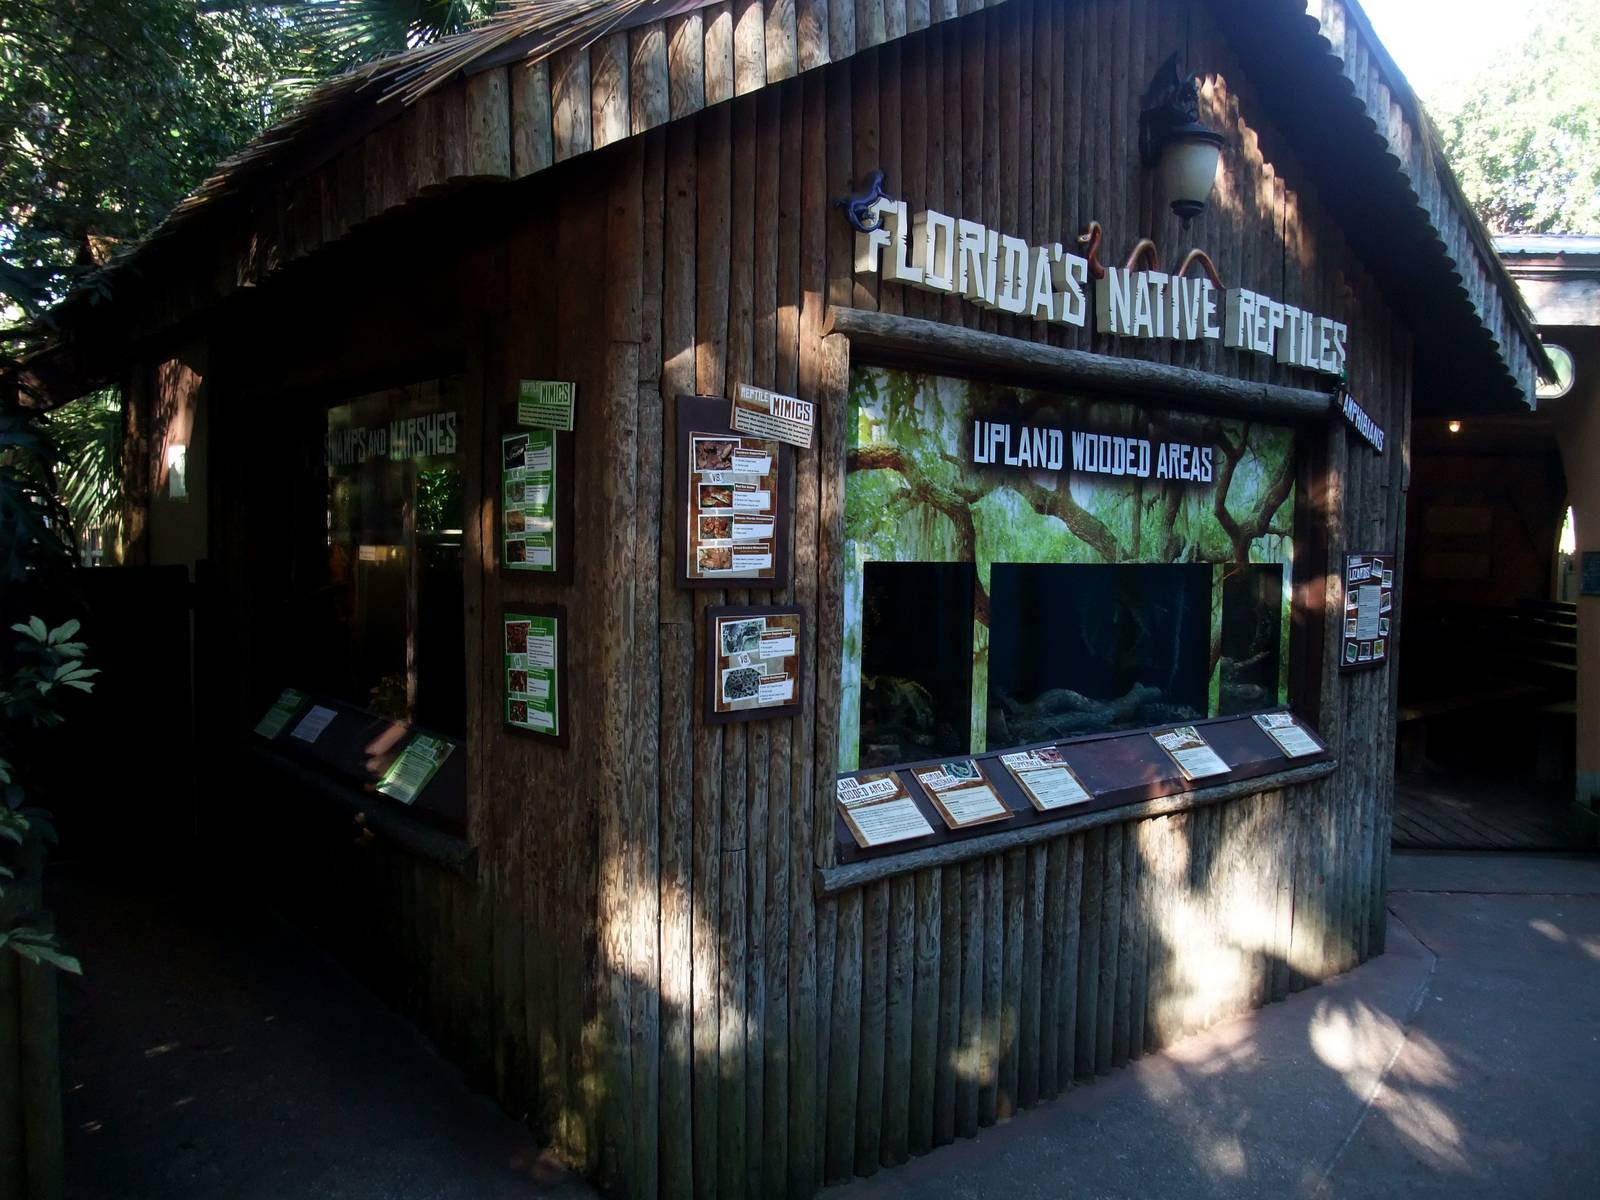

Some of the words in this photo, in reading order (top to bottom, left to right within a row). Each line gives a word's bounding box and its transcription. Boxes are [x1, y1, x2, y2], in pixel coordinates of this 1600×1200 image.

[857, 197, 1088, 327] FLORIDA'S
[1103, 267, 1220, 341] NATIVE
[1232, 287, 1348, 376] REPTILES
[541, 383, 569, 403] MIMICS
[773, 396, 811, 421] MIMICS
[368, 428, 386, 457] AND
[389, 411, 457, 461] MARSHES
[1343, 393, 1385, 452] AMPHIBIANS
[974, 420, 1064, 471] UPLAND
[1071, 430, 1150, 478] WOODED
[1156, 442, 1213, 483] AREAS
[838, 779, 858, 791] LAND
[838, 786, 869, 802] WOODED
[868, 781, 895, 795] AREAS
